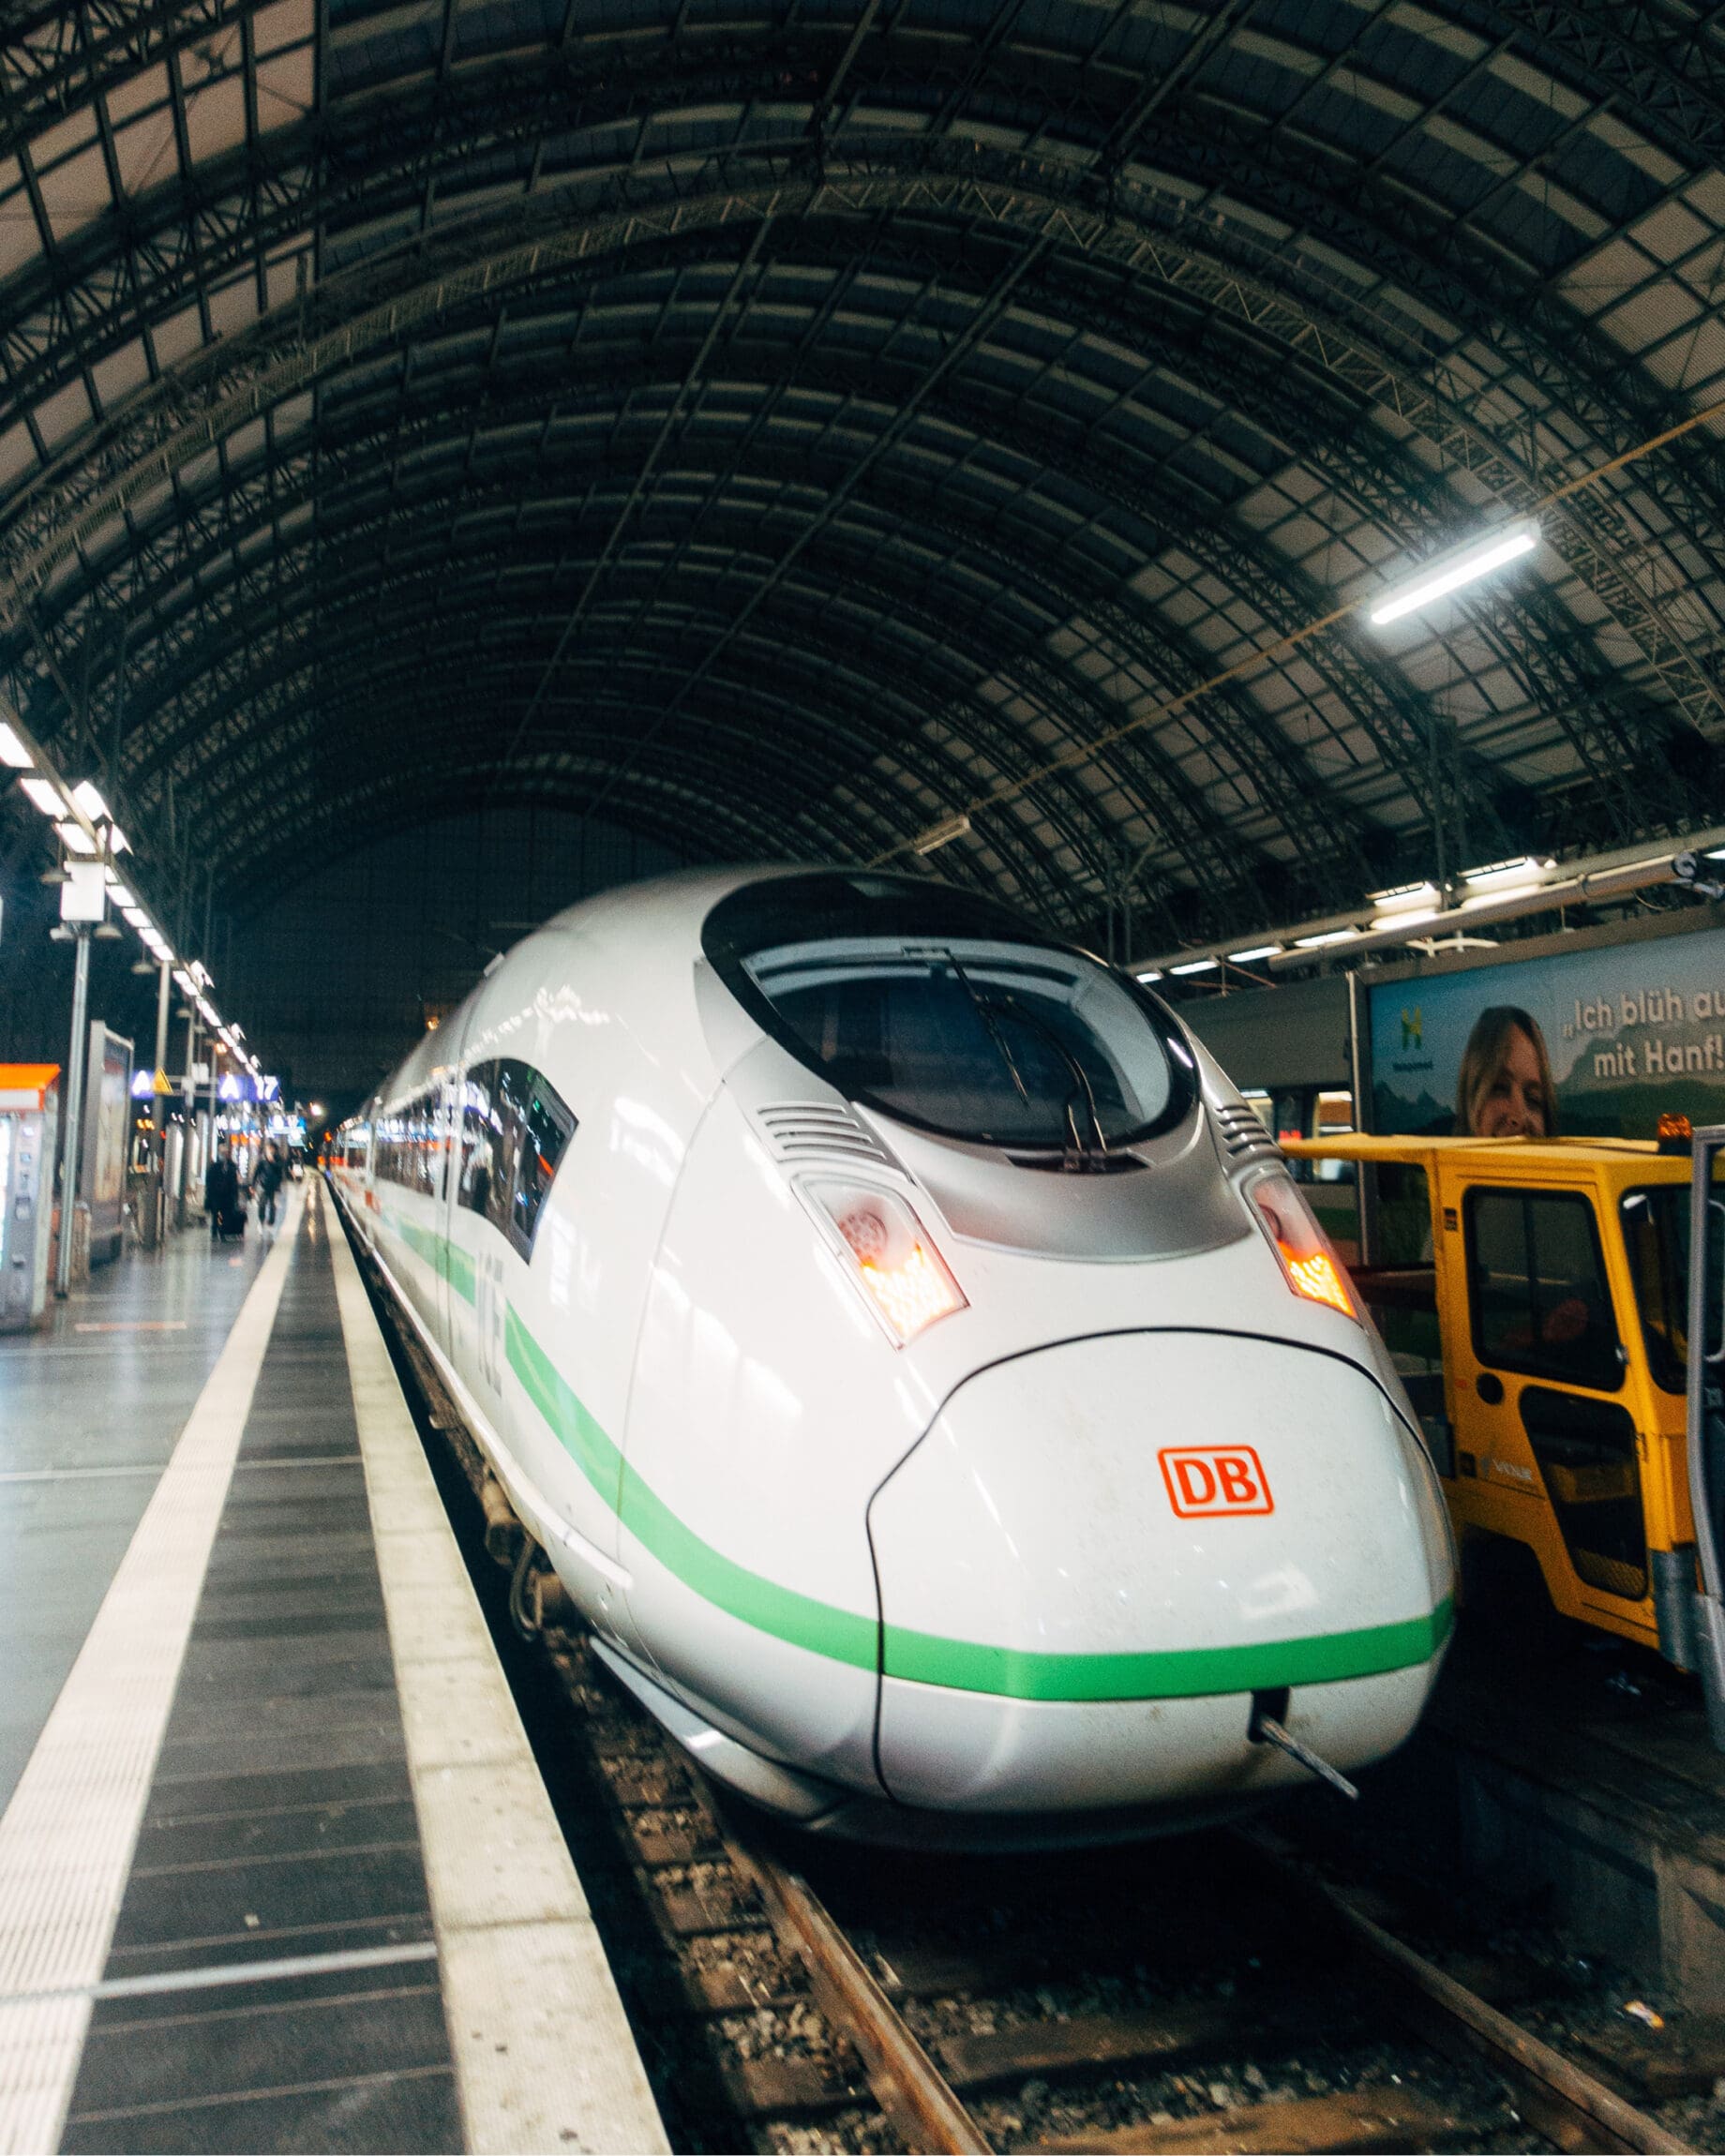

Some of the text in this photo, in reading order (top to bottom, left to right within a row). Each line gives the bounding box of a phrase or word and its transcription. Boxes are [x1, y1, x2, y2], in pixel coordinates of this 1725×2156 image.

[1620, 987, 1685, 1026] blüh
[1594, 1033, 1725, 1077] mit Hanf!
[218, 1073, 279, 1100] A 17
[1172, 1457, 1259, 1505] DB
